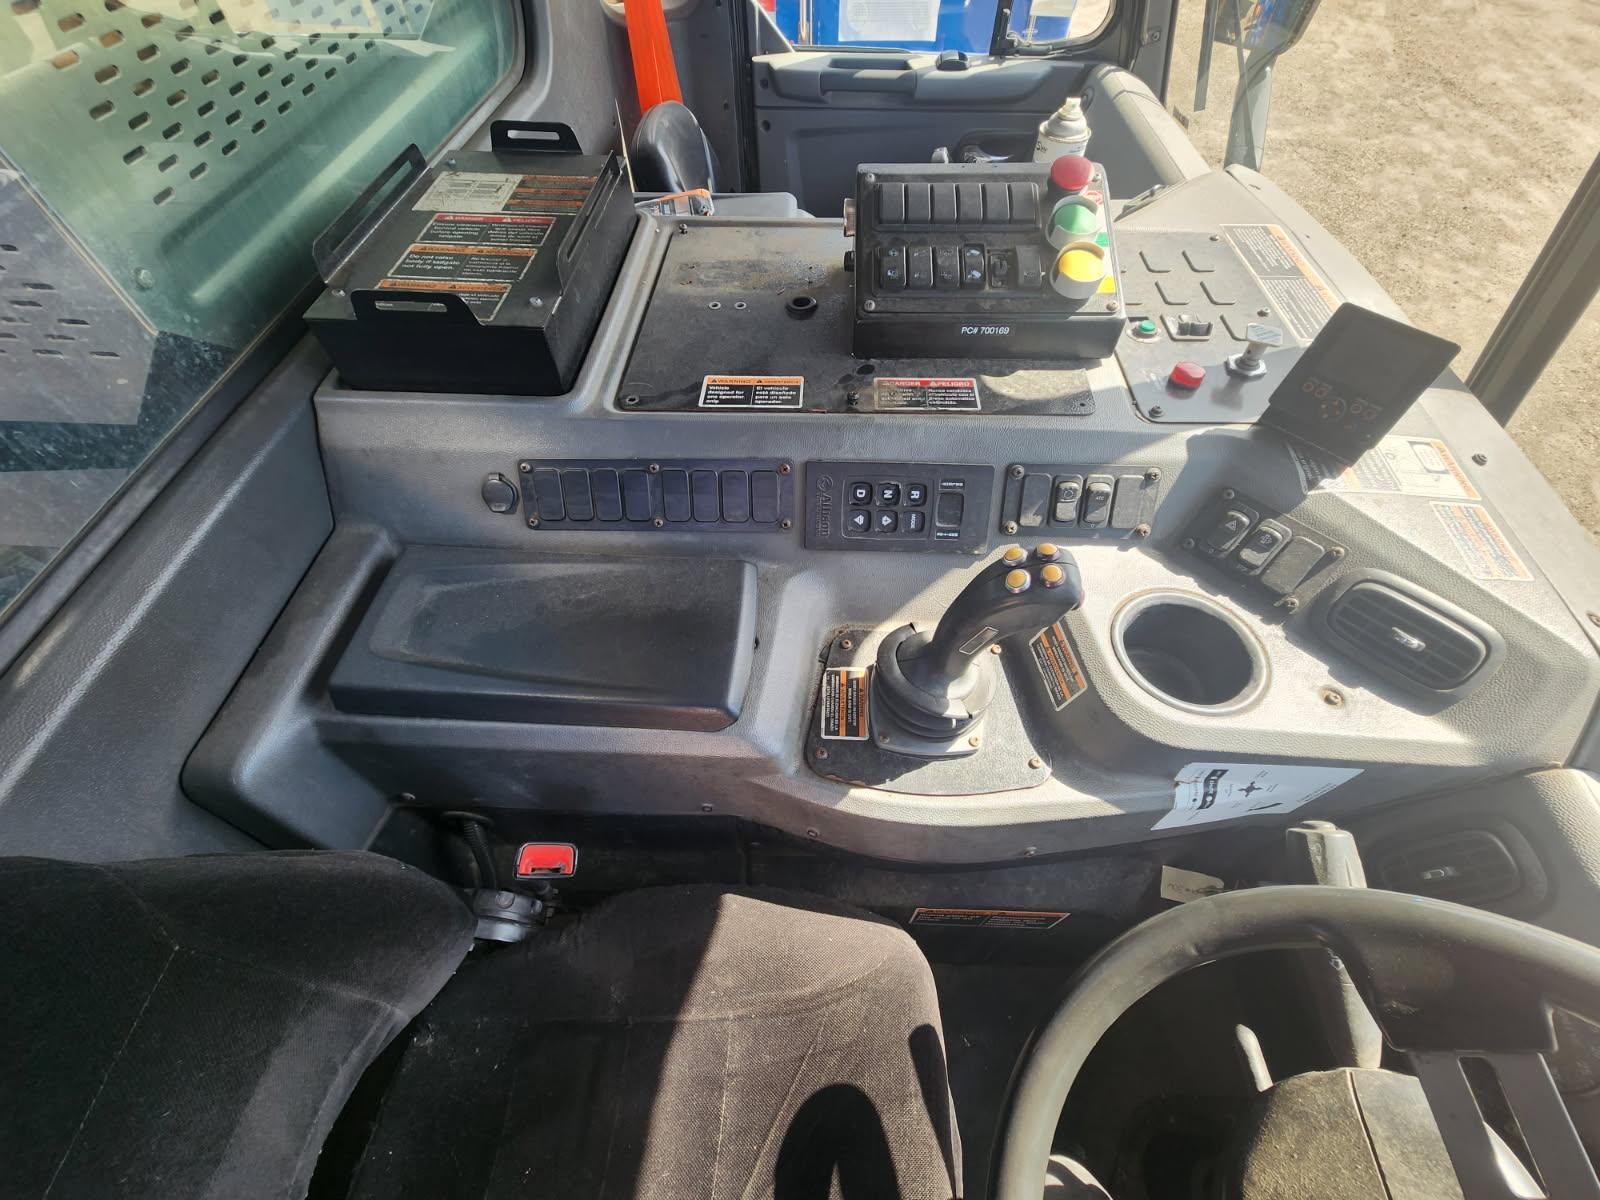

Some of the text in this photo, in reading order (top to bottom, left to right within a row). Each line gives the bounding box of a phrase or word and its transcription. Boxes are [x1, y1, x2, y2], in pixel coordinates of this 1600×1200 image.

[961, 326, 1010, 335] PC# 700169
[857, 489, 866, 498] D
[883, 489, 893, 499] N
[910, 490, 920, 499] R
